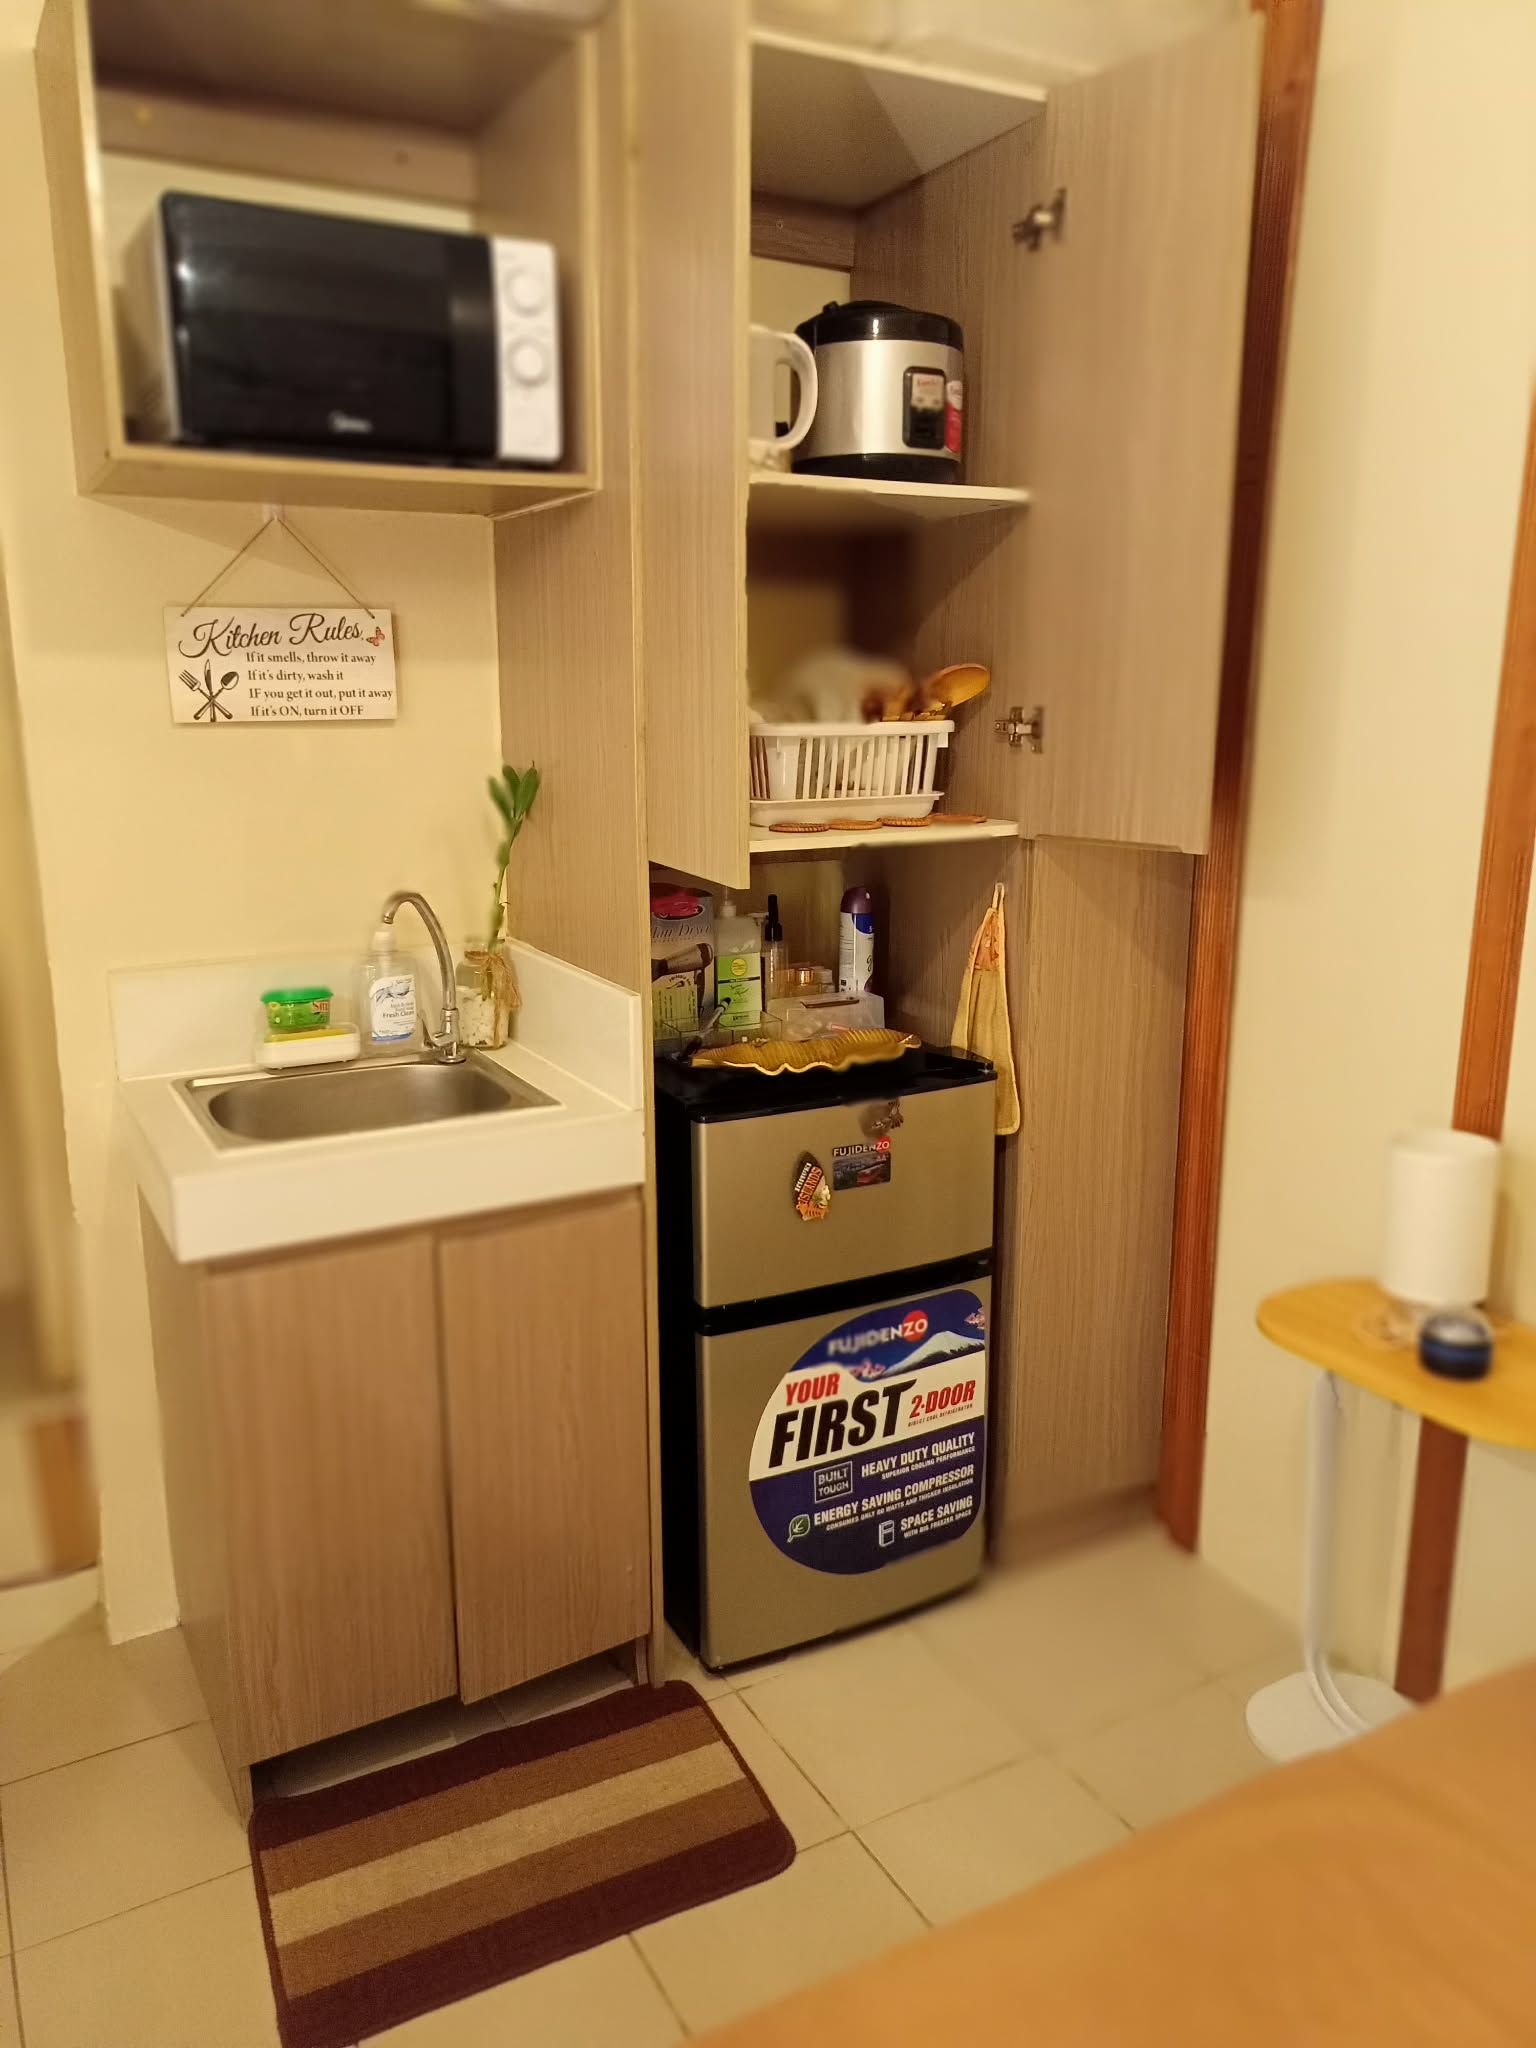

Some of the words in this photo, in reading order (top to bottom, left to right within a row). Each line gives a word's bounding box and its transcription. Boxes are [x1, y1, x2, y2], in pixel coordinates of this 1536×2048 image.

[178, 616, 282, 658] Kitchen
[289, 613, 362, 646] Rules
[246, 651, 256, 662] If
[256, 652, 265, 662] it
[267, 651, 305, 663] smells,
[306, 651, 339, 662] throw
[341, 652, 348, 662] it
[351, 655, 376, 665] away
[248, 670, 257, 680] If
[259, 670, 274, 680] it's
[276, 669, 305, 683] dirty,
[307, 669, 334, 680] wash
[336, 671, 344, 680] it
[249, 688, 261, 698] IF
[264, 690, 284, 701] you
[286, 690, 302, 702] get
[305, 688, 313, 698] it
[315, 689, 337, 699] out,
[338, 689, 356, 701] put
[358, 688, 366, 698] it
[368, 690, 393, 700] away
[251, 706, 260, 716] If
[262, 705, 277, 716] it's
[279, 705, 302, 717] ON,
[304, 706, 327, 716] turn
[330, 706, 337, 716] it
[339, 705, 363, 716] OFF
[833, 1140, 890, 1157] FUJIDENZO
[828, 1318, 928, 1356] FUJIDENZO
[786, 1372, 841, 1407] YOUR
[908, 1379, 976, 1419] 2-DOOR
[768, 1378, 918, 1469] FIRST
[861, 1455, 898, 1478] HEAVY
[900, 1445, 928, 1465] DUTY
[931, 1431, 975, 1456] QUALITY
[881, 1466, 910, 1480] SUPERIOR
[911, 1458, 935, 1471] COOLING
[935, 1445, 975, 1463] PERFORMANCE
[818, 1467, 848, 1485] BUILT
[818, 1481, 849, 1497] TOUGH
[814, 1501, 859, 1526] ENERGY
[861, 1487, 902, 1511] SAVING
[904, 1463, 974, 1498] COMPRESSOR
[885, 1501, 905, 1514] WATTS
[900, 1509, 934, 1531] SPACE
[937, 1495, 973, 1518] SAVING
